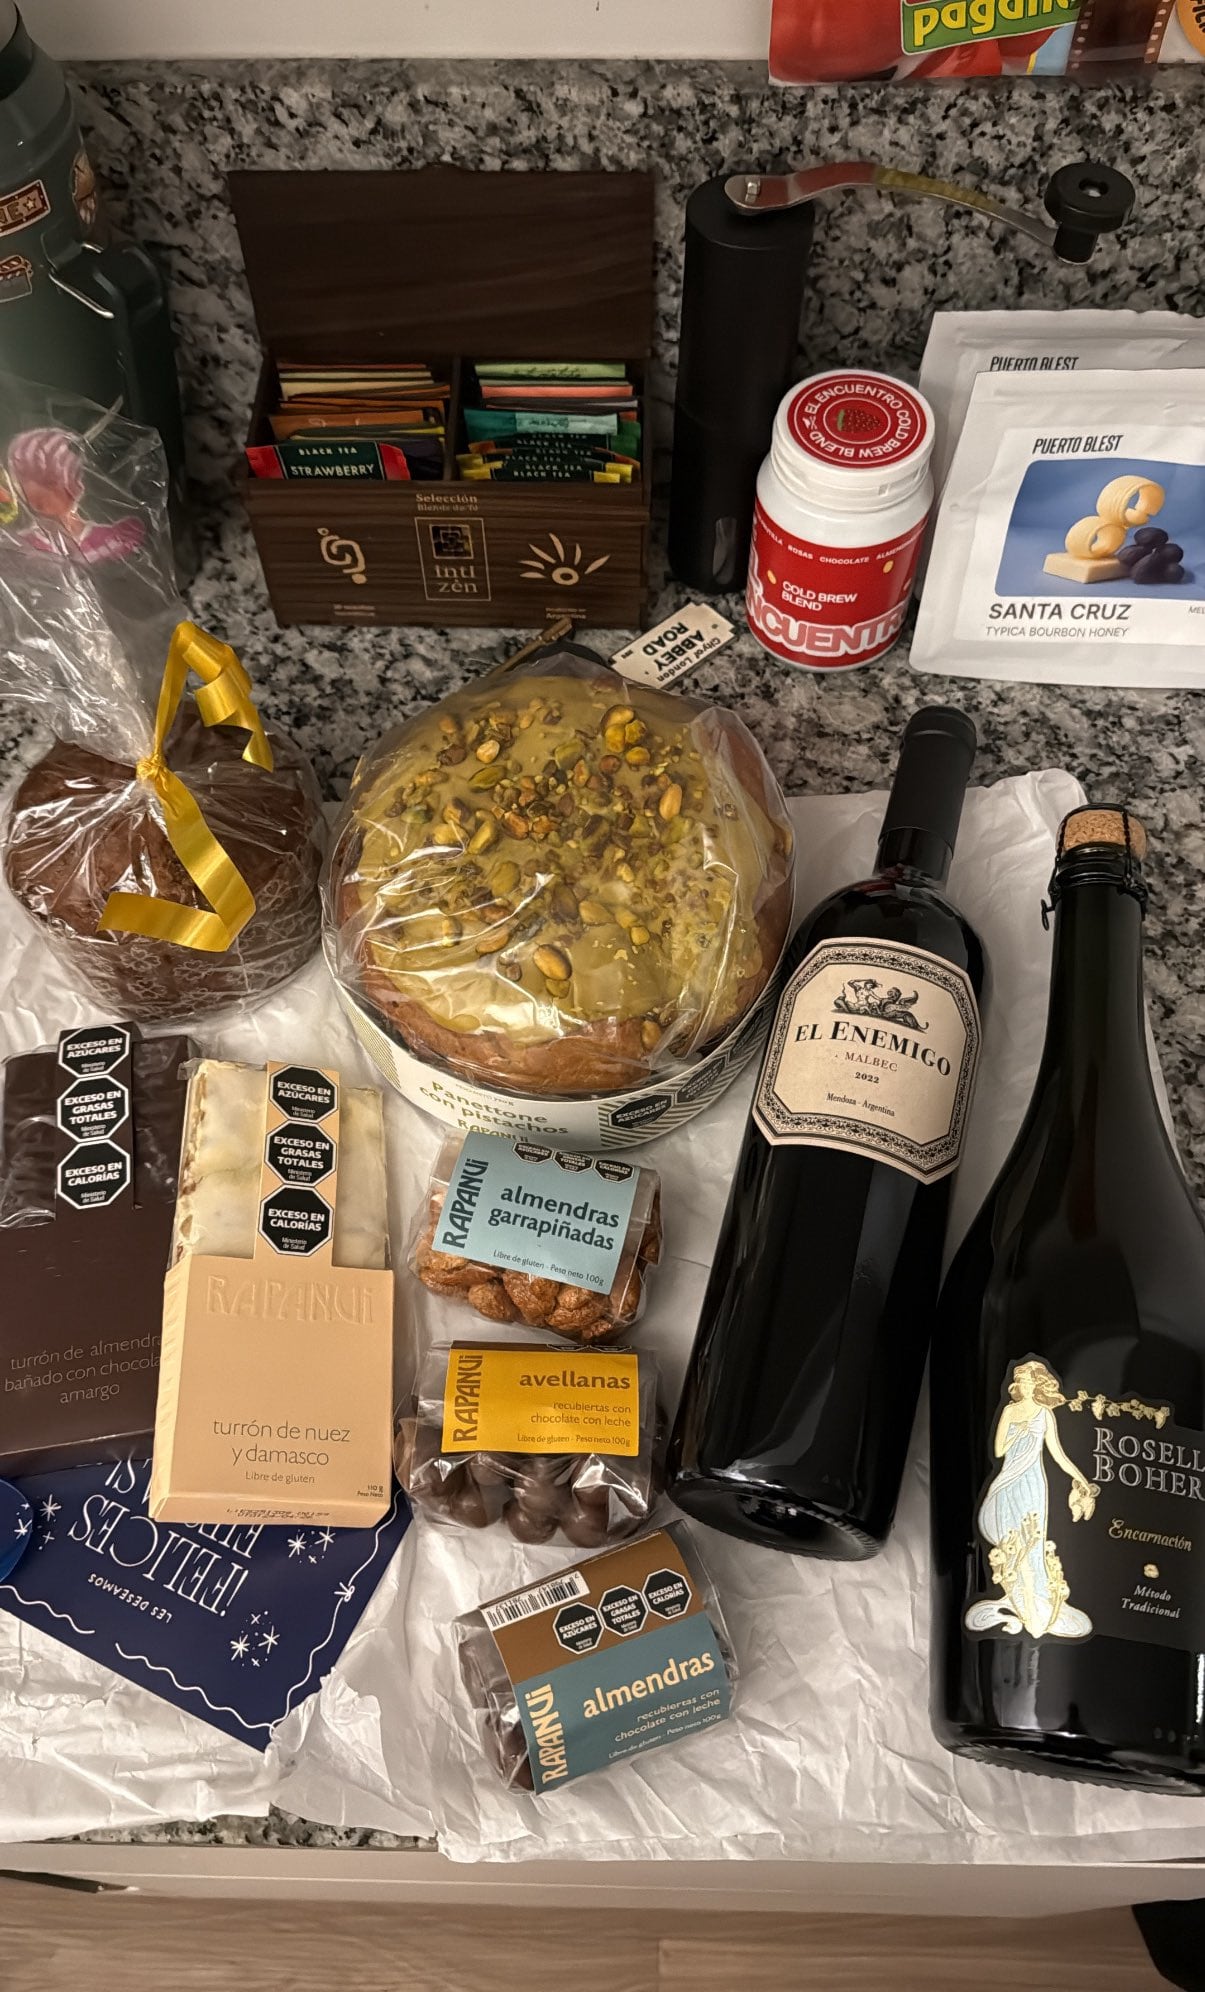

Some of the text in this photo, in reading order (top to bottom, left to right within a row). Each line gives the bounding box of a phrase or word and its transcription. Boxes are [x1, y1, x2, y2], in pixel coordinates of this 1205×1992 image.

[989, 356, 1079, 371] PUERTO BLEST
[805, 384, 912, 459] EL ENCUENTRO COLD BREW BLEND
[1032, 434, 1124, 455] PUERTO BLEST
[291, 464, 375, 477] STRAWBERRY
[416, 493, 478, 504] Selección
[820, 556, 870, 565] CHOCOLATE
[782, 581, 858, 604] COLD BREW
[782, 592, 822, 611] BLEND
[988, 603, 1132, 621] SANTA CRUZ
[643, 622, 689, 656] ROAD
[986, 626, 1129, 638] TYPICA BOURBON HONEY
[654, 630, 705, 672] ABBEY
[657, 657, 693, 682] London
[66, 1038, 123, 1051] EXCESO EN
[66, 1045, 122, 1059] AZÚCARES
[794, 1020, 951, 1077] EL ENEMIGO
[845, 1051, 898, 1072] MALBEC
[855, 1071, 880, 1084] 2022
[64, 1090, 122, 1106] EXCESO EN
[277, 1081, 331, 1096] EXCESO EN
[278, 1089, 331, 1104] AZÚCARES
[72, 1101, 114, 1115] GRASAS
[826, 1092, 896, 1117] Mendoza Argentina
[69, 1111, 118, 1125] TOTALES
[273, 1136, 330, 1151] EXCESO EN
[281, 1147, 322, 1159] GRASAS
[65, 1162, 122, 1178] EXCESO EN
[277, 1156, 325, 1169] TOTALES
[67, 1170, 120, 1187] CALORÍAS
[268, 1209, 325, 1222] EXCESO EN
[500, 1185, 620, 1228] almendras
[270, 1217, 322, 1232] CALORÍAS
[487, 1207, 615, 1251] garrapiñadas
[493, 1249, 605, 1287] Libre de gluten Peso neto 100g
[11, 1350, 60, 1370] turrón
[63, 1345, 85, 1361] de
[5, 1353, 161, 1392] bañado con chocola
[519, 1370, 631, 1390] avellanas
[60, 1384, 120, 1404] amargo
[553, 1401, 632, 1414] recubiertas con
[530, 1412, 632, 1428] chocolate con leche
[213, 1419, 351, 1443] turrón de nuez
[517, 1434, 536, 1443] Libre
[536, 1435, 546, 1443] de
[546, 1434, 570, 1445] gluten
[575, 1434, 593, 1443] Peso
[593, 1436, 611, 1445] neto
[231, 1444, 330, 1466] y damasco
[1093, 1427, 1205, 1473] ROSELL
[245, 1471, 315, 1485] Libre de gluten
[1092, 1454, 1205, 1501] BOHER
[1108, 1518, 1192, 1552] Encarnación
[88, 1572, 173, 1625] LES DESEAMOS
[648, 1581, 683, 1600] EXCESO EN
[652, 1587, 685, 1606] CALORÍAS
[1134, 1584, 1172, 1601] Método
[602, 1594, 639, 1613] EXCESO EN
[610, 1602, 638, 1618] GRASAS
[1121, 1598, 1183, 1620] Tradicional
[559, 1615, 596, 1634] EXCESO EN
[611, 1609, 641, 1625] TOTALES
[562, 1622, 598, 1640] AZÚCARES
[582, 1651, 716, 1719] almendras
[637, 1689, 720, 1723] recubiertas con
[615, 1699, 721, 1742] chocolate con leche
